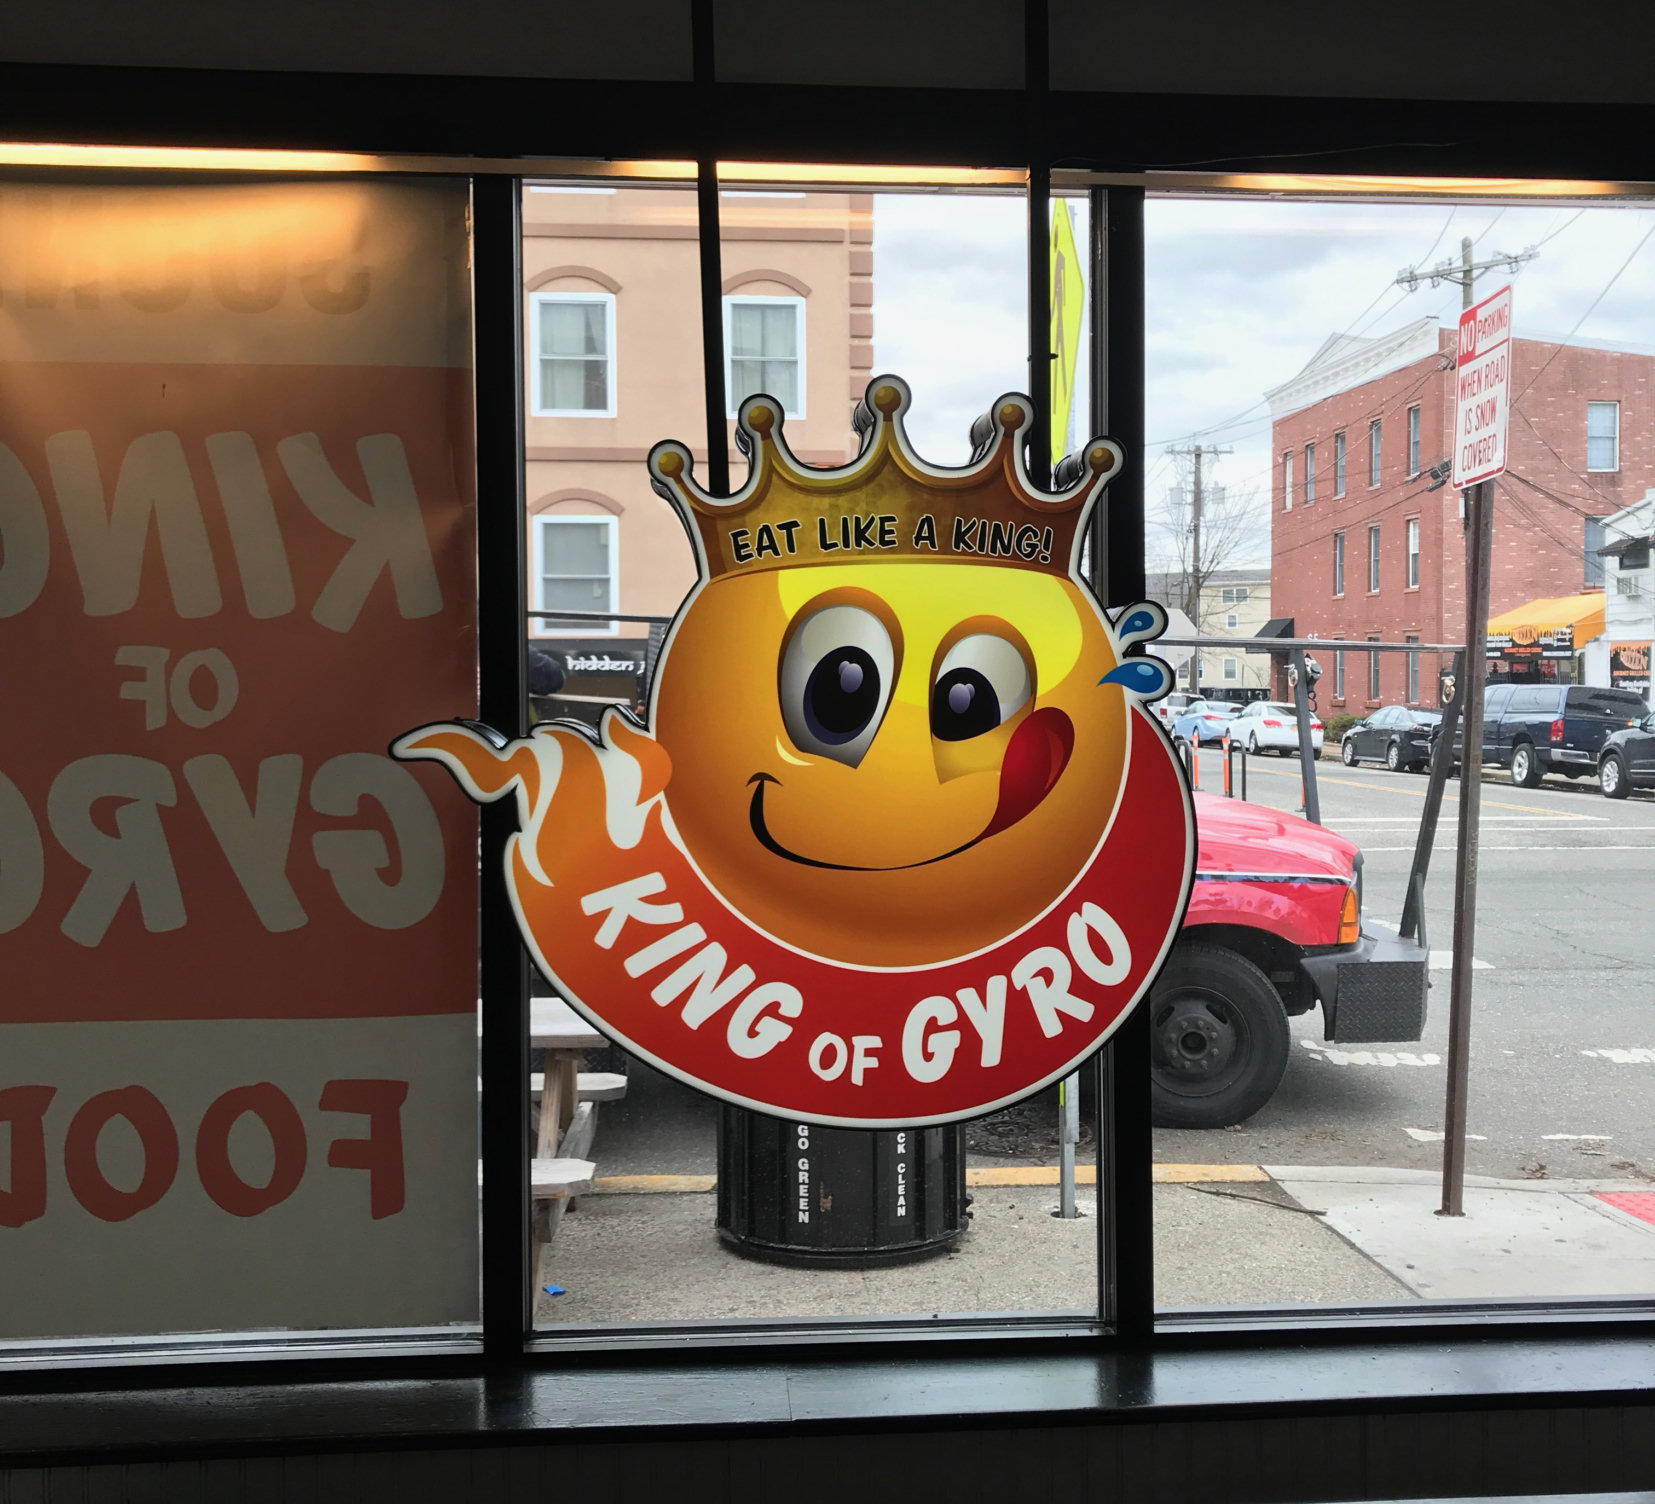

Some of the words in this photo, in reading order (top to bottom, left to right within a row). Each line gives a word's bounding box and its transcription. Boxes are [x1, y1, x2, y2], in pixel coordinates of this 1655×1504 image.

[1459, 319, 1475, 357] NO
[1477, 303, 1509, 344] PARKING
[1460, 368, 1482, 402] WHEN
[1484, 355, 1506, 392] ROAD
[1464, 407, 1472, 437] IS
[1474, 396, 1498, 431] SNOW
[1461, 433, 1497, 473] COVERED
[729, 519, 801, 563] EAT
[817, 513, 898, 551] LIKE
[912, 514, 938, 551] A
[952, 516, 1054, 564] KING!
[565, 654, 634, 672] hidden
[580, 871, 804, 1059] KING
[808, 1031, 883, 1086] OF
[902, 901, 1132, 1084] GYRO
[797, 1124, 809, 1150] GO
[797, 1158, 810, 1223] GREEN
[896, 1163, 906, 1217] CLEAN
